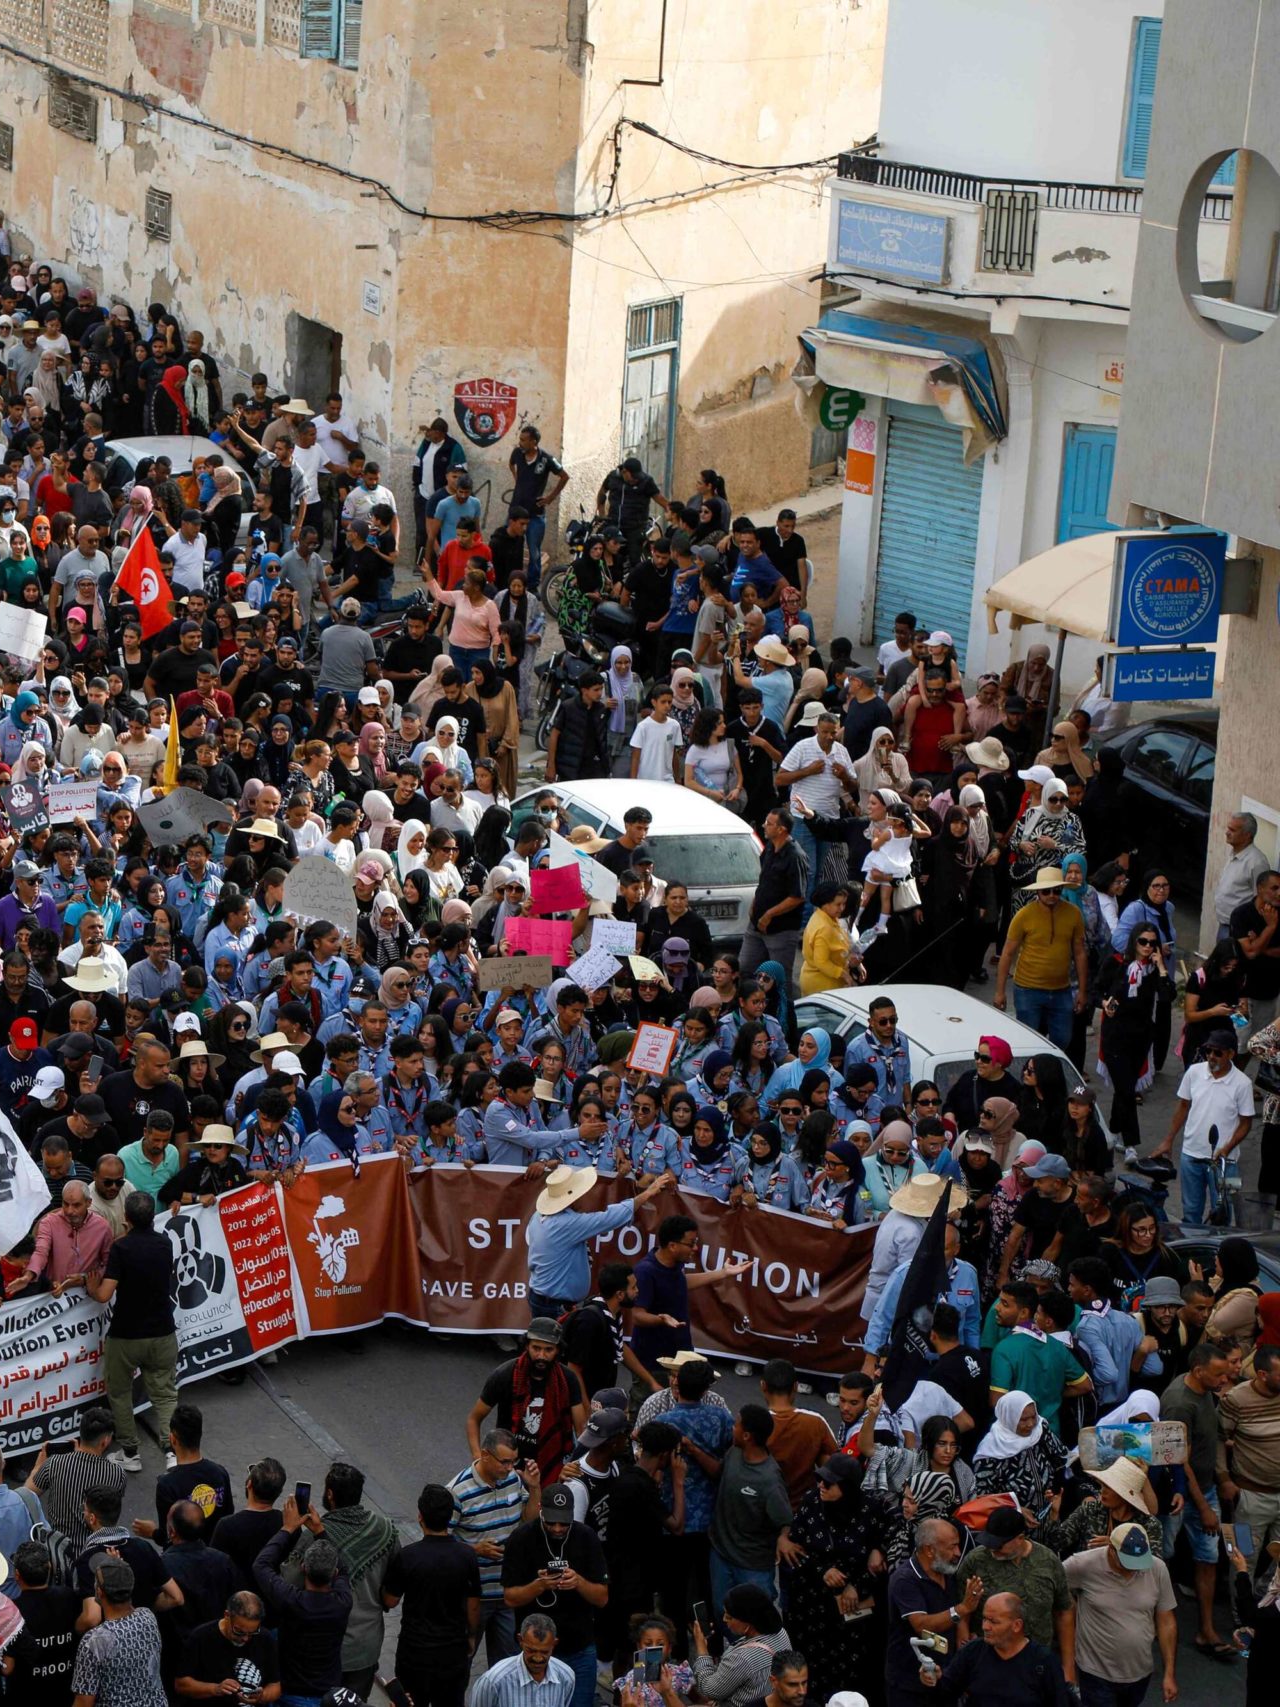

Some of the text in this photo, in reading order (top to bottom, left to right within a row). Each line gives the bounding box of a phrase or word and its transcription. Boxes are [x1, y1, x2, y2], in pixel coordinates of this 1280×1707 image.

[461, 382, 511, 396] ASG
[846, 480, 870, 493] orange
[1145, 577, 1201, 594] CTAMA
[1118, 664, 1211, 687] تأمينات كتاما
[65, 787, 97, 796] POLLUTION
[49, 802, 73, 816] نعيش
[75, 800, 95, 813] نحب
[227, 1207, 276, 1232] 05 جوان 2012
[232, 1226, 281, 1252] 05 جوان 2022
[235, 1255, 271, 1275] سنوات
[467, 1217, 821, 1299] ST POUTION
[242, 1273, 273, 1299] النضال
[314, 1284, 362, 1300] Stop Pollution
[483, 1281, 528, 1301] GAB
[64, 1292, 83, 1313] in
[183, 1302, 232, 1326] POLLUTION
[243, 1292, 281, 1317] #Decade
[178, 1324, 223, 1349] نحب نعيش
[733, 1314, 818, 1349] نعيش
[74, 1339, 106, 1365] لوث
[192, 1339, 233, 1367] نحب
[33, 1351, 69, 1381] ليس
[17, 1383, 68, 1419] الجرائم
[48, 1408, 83, 1436] Gab
